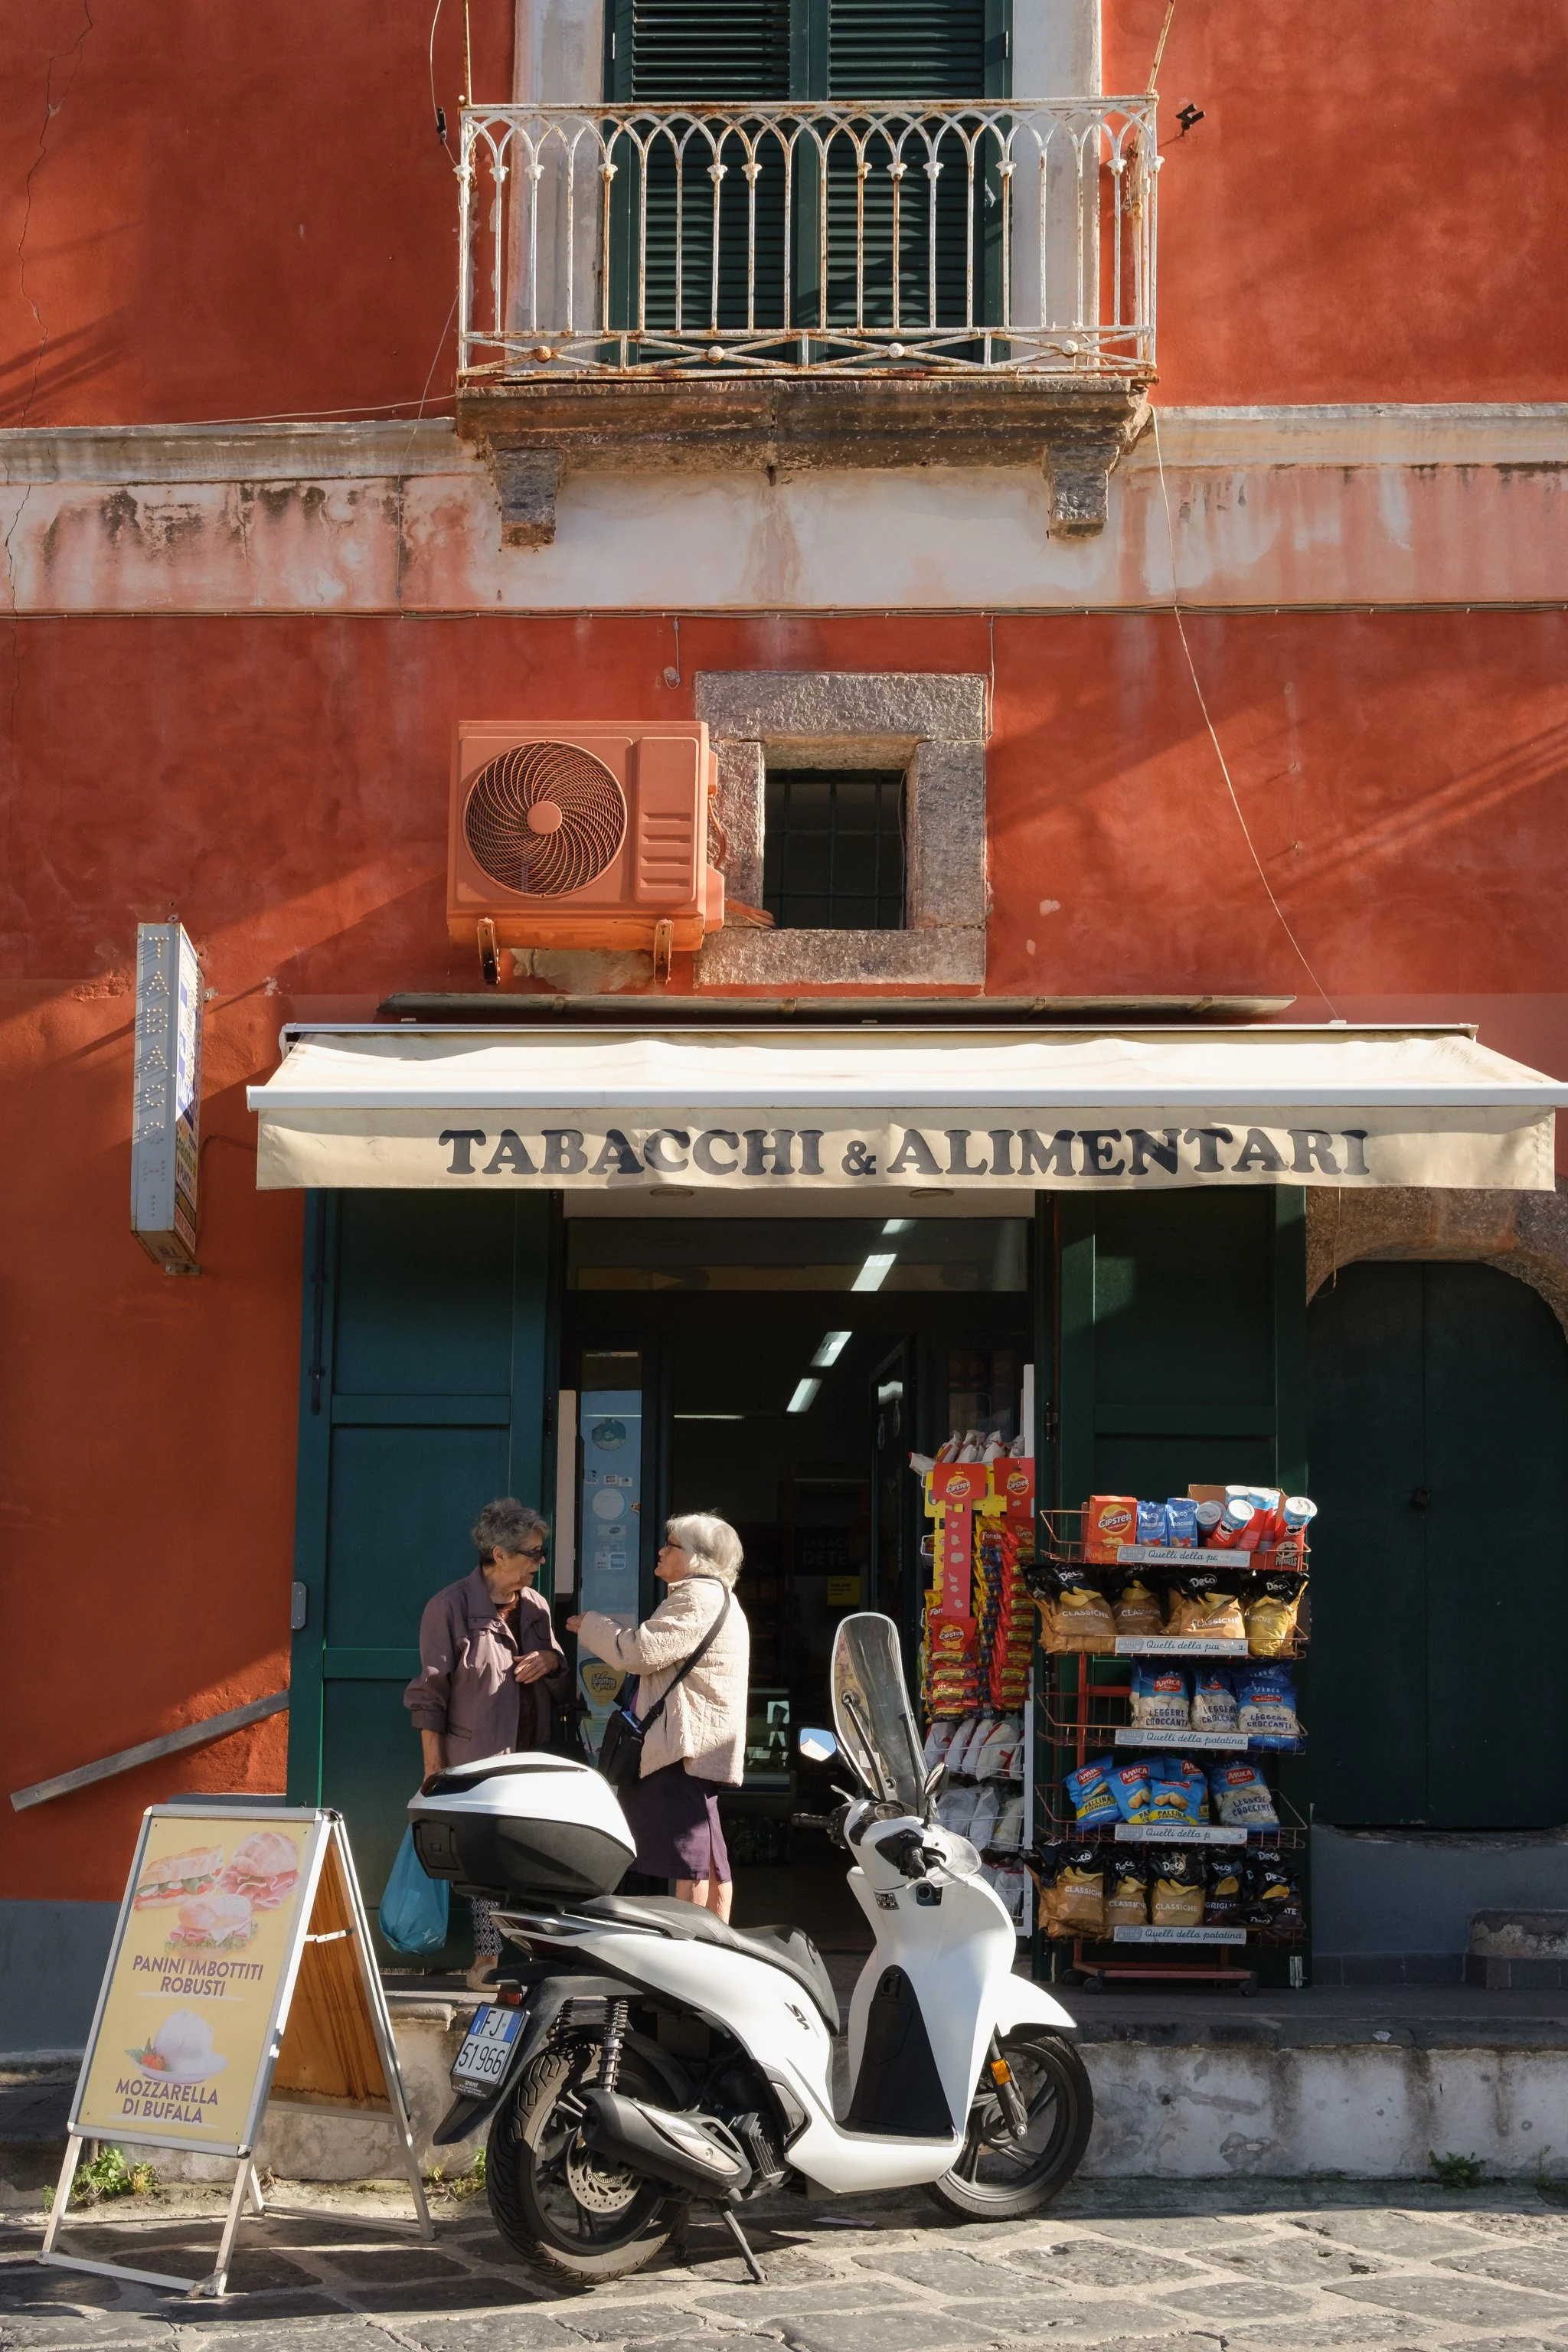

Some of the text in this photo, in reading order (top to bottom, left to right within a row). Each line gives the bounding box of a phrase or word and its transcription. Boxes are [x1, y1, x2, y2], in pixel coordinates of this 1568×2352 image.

[438, 1128, 1370, 1176] TABACCHI & ALIMENTARI
[1148, 1550, 1177, 1559] Quelli
[1179, 1550, 1204, 1560] della
[1062, 1609, 1109, 1619] CLASSICHE
[1146, 1640, 1176, 1649] Quelli
[1178, 1641, 1202, 1650] della
[1149, 1708, 1185, 1717] LEGGERE
[1146, 1732, 1175, 1741] Quelli
[1178, 1733, 1202, 1743] della
[1204, 1736, 1246, 1745] patatina.
[1122, 1767, 1148, 1780] AMICA
[1228, 1769, 1252, 1780] AMICA
[1145, 1828, 1175, 1837] Quelli
[1177, 1828, 1201, 1838] della
[1162, 1861, 1184, 1871] Deco
[1155, 1903, 1198, 1912] CLASSICHE
[1145, 1929, 1174, 1938] Quelli
[1176, 1929, 1200, 1938] della
[1203, 1931, 1244, 1940] patatina.
[132, 1955, 264, 1981] PANINI IMBOTTITI
[160, 1975, 226, 1997] ROBUSTI
[480, 2010, 505, 2037] FJ
[459, 2042, 505, 2075] 51966
[115, 2078, 219, 2105] MOZZARELLA
[122, 2098, 204, 2124] DI BUFALA
